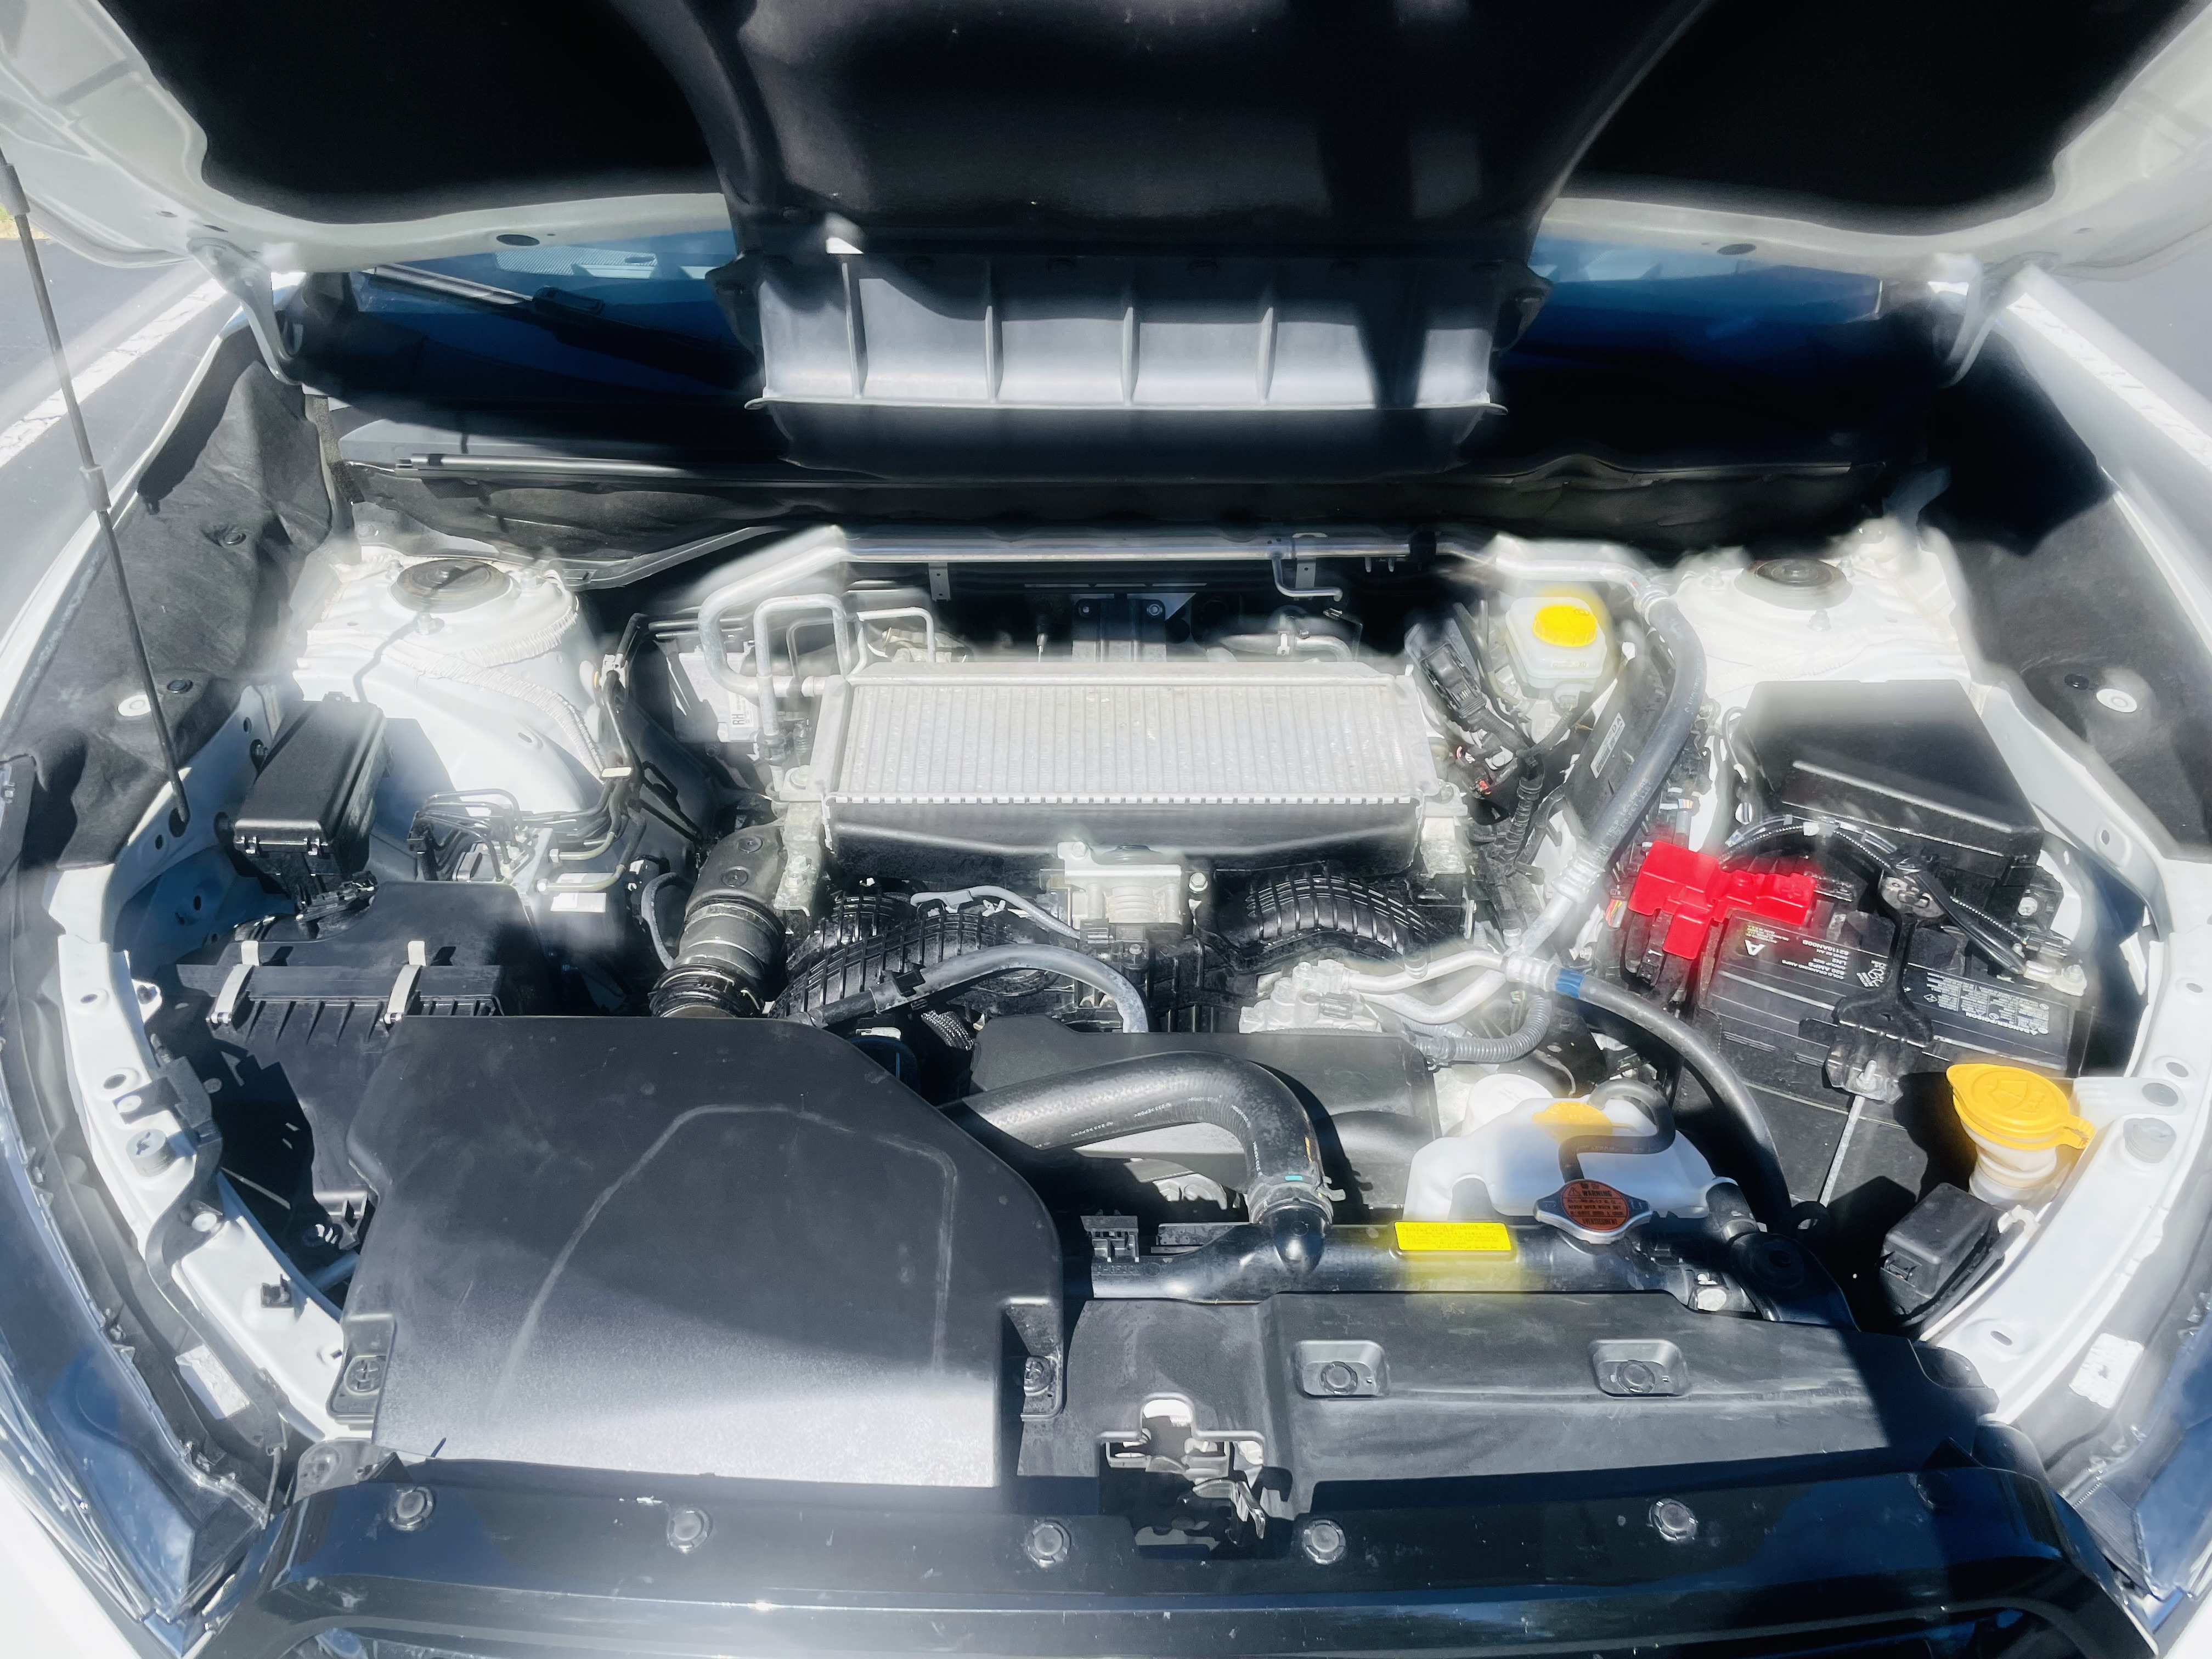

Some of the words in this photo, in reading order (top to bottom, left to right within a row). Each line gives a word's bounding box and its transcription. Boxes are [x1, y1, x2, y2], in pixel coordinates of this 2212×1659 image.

[1798, 964, 1827, 975] CRANKING
[1808, 962, 1830, 972] AMPS
[1826, 962, 1846, 970] GROUP
[1965, 1012, 2030, 1034] DANGER/POISON
